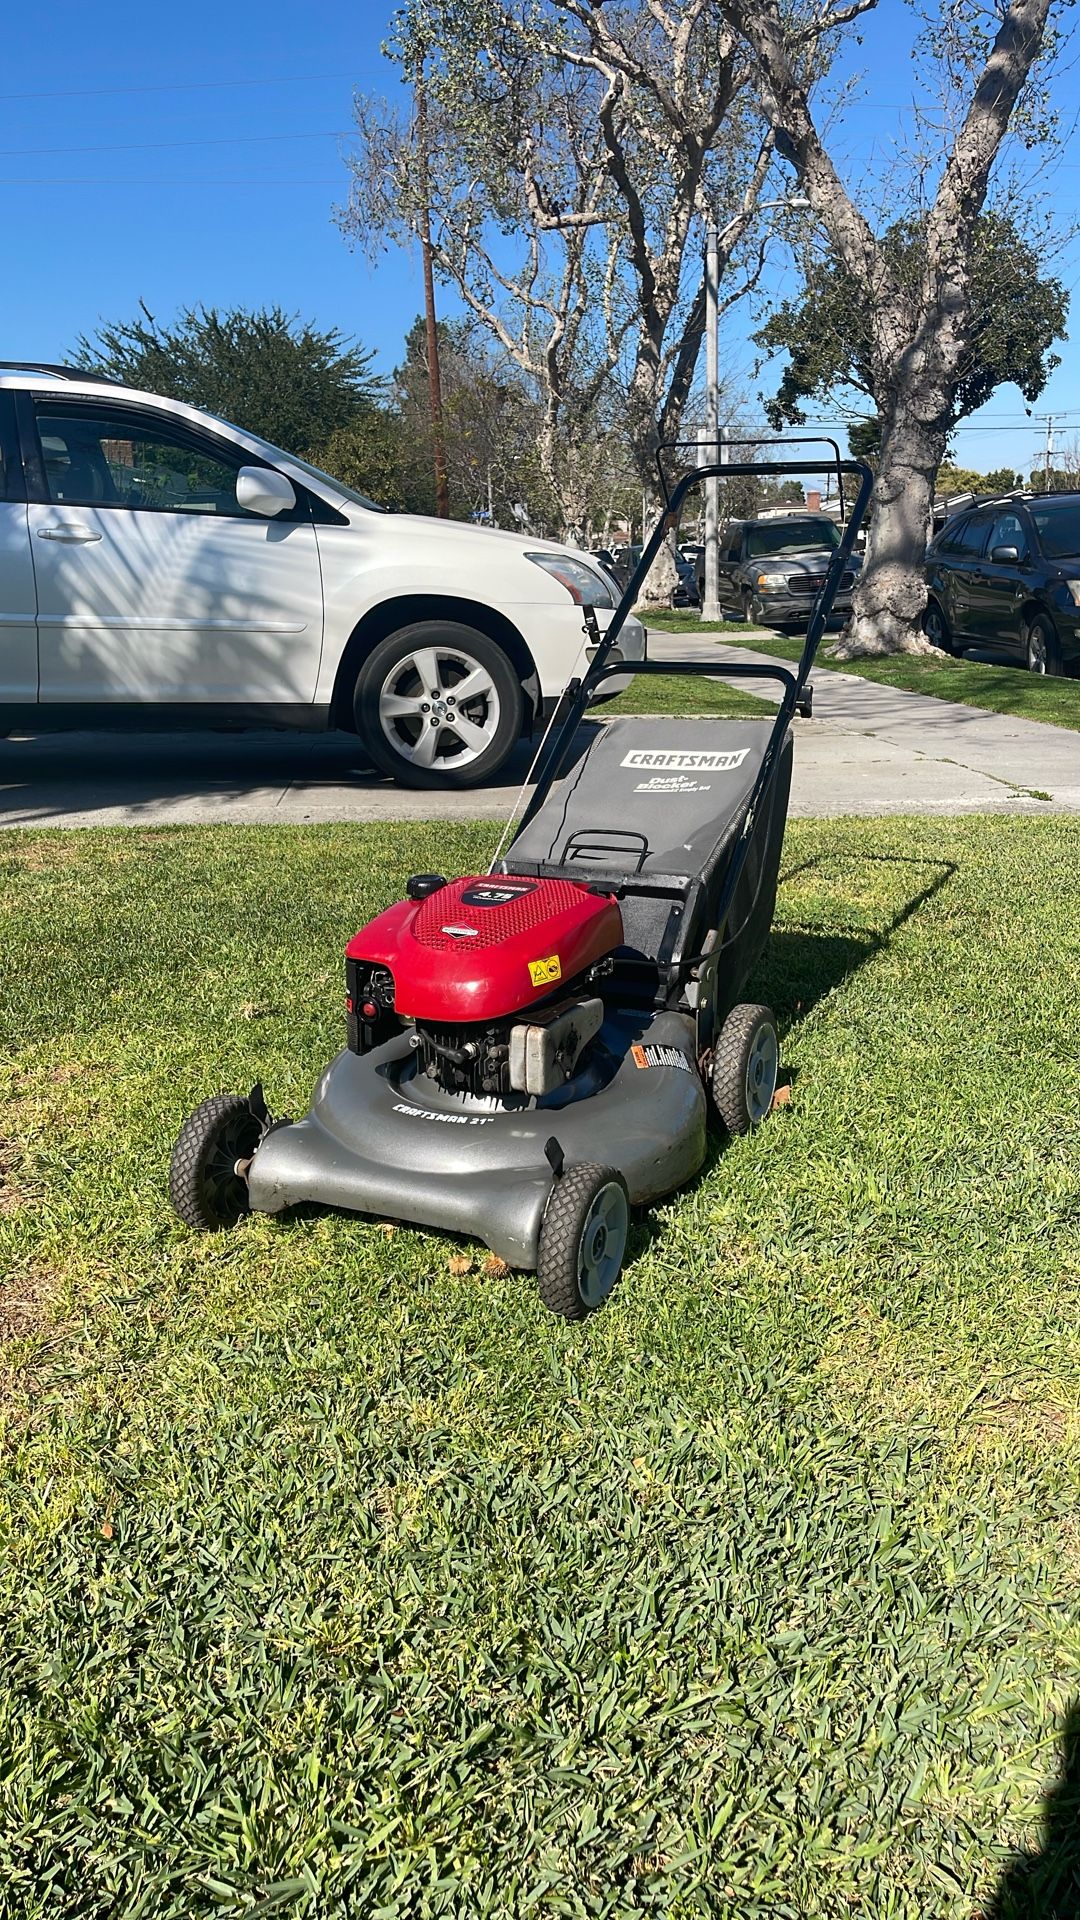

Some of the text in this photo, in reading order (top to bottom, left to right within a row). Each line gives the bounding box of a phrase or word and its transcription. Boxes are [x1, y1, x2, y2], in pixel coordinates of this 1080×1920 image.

[628, 752, 743, 767] CRAFTSMAN
[636, 781, 697, 790] Blocker
[392, 1103, 468, 1124] CRAFTSMAN
